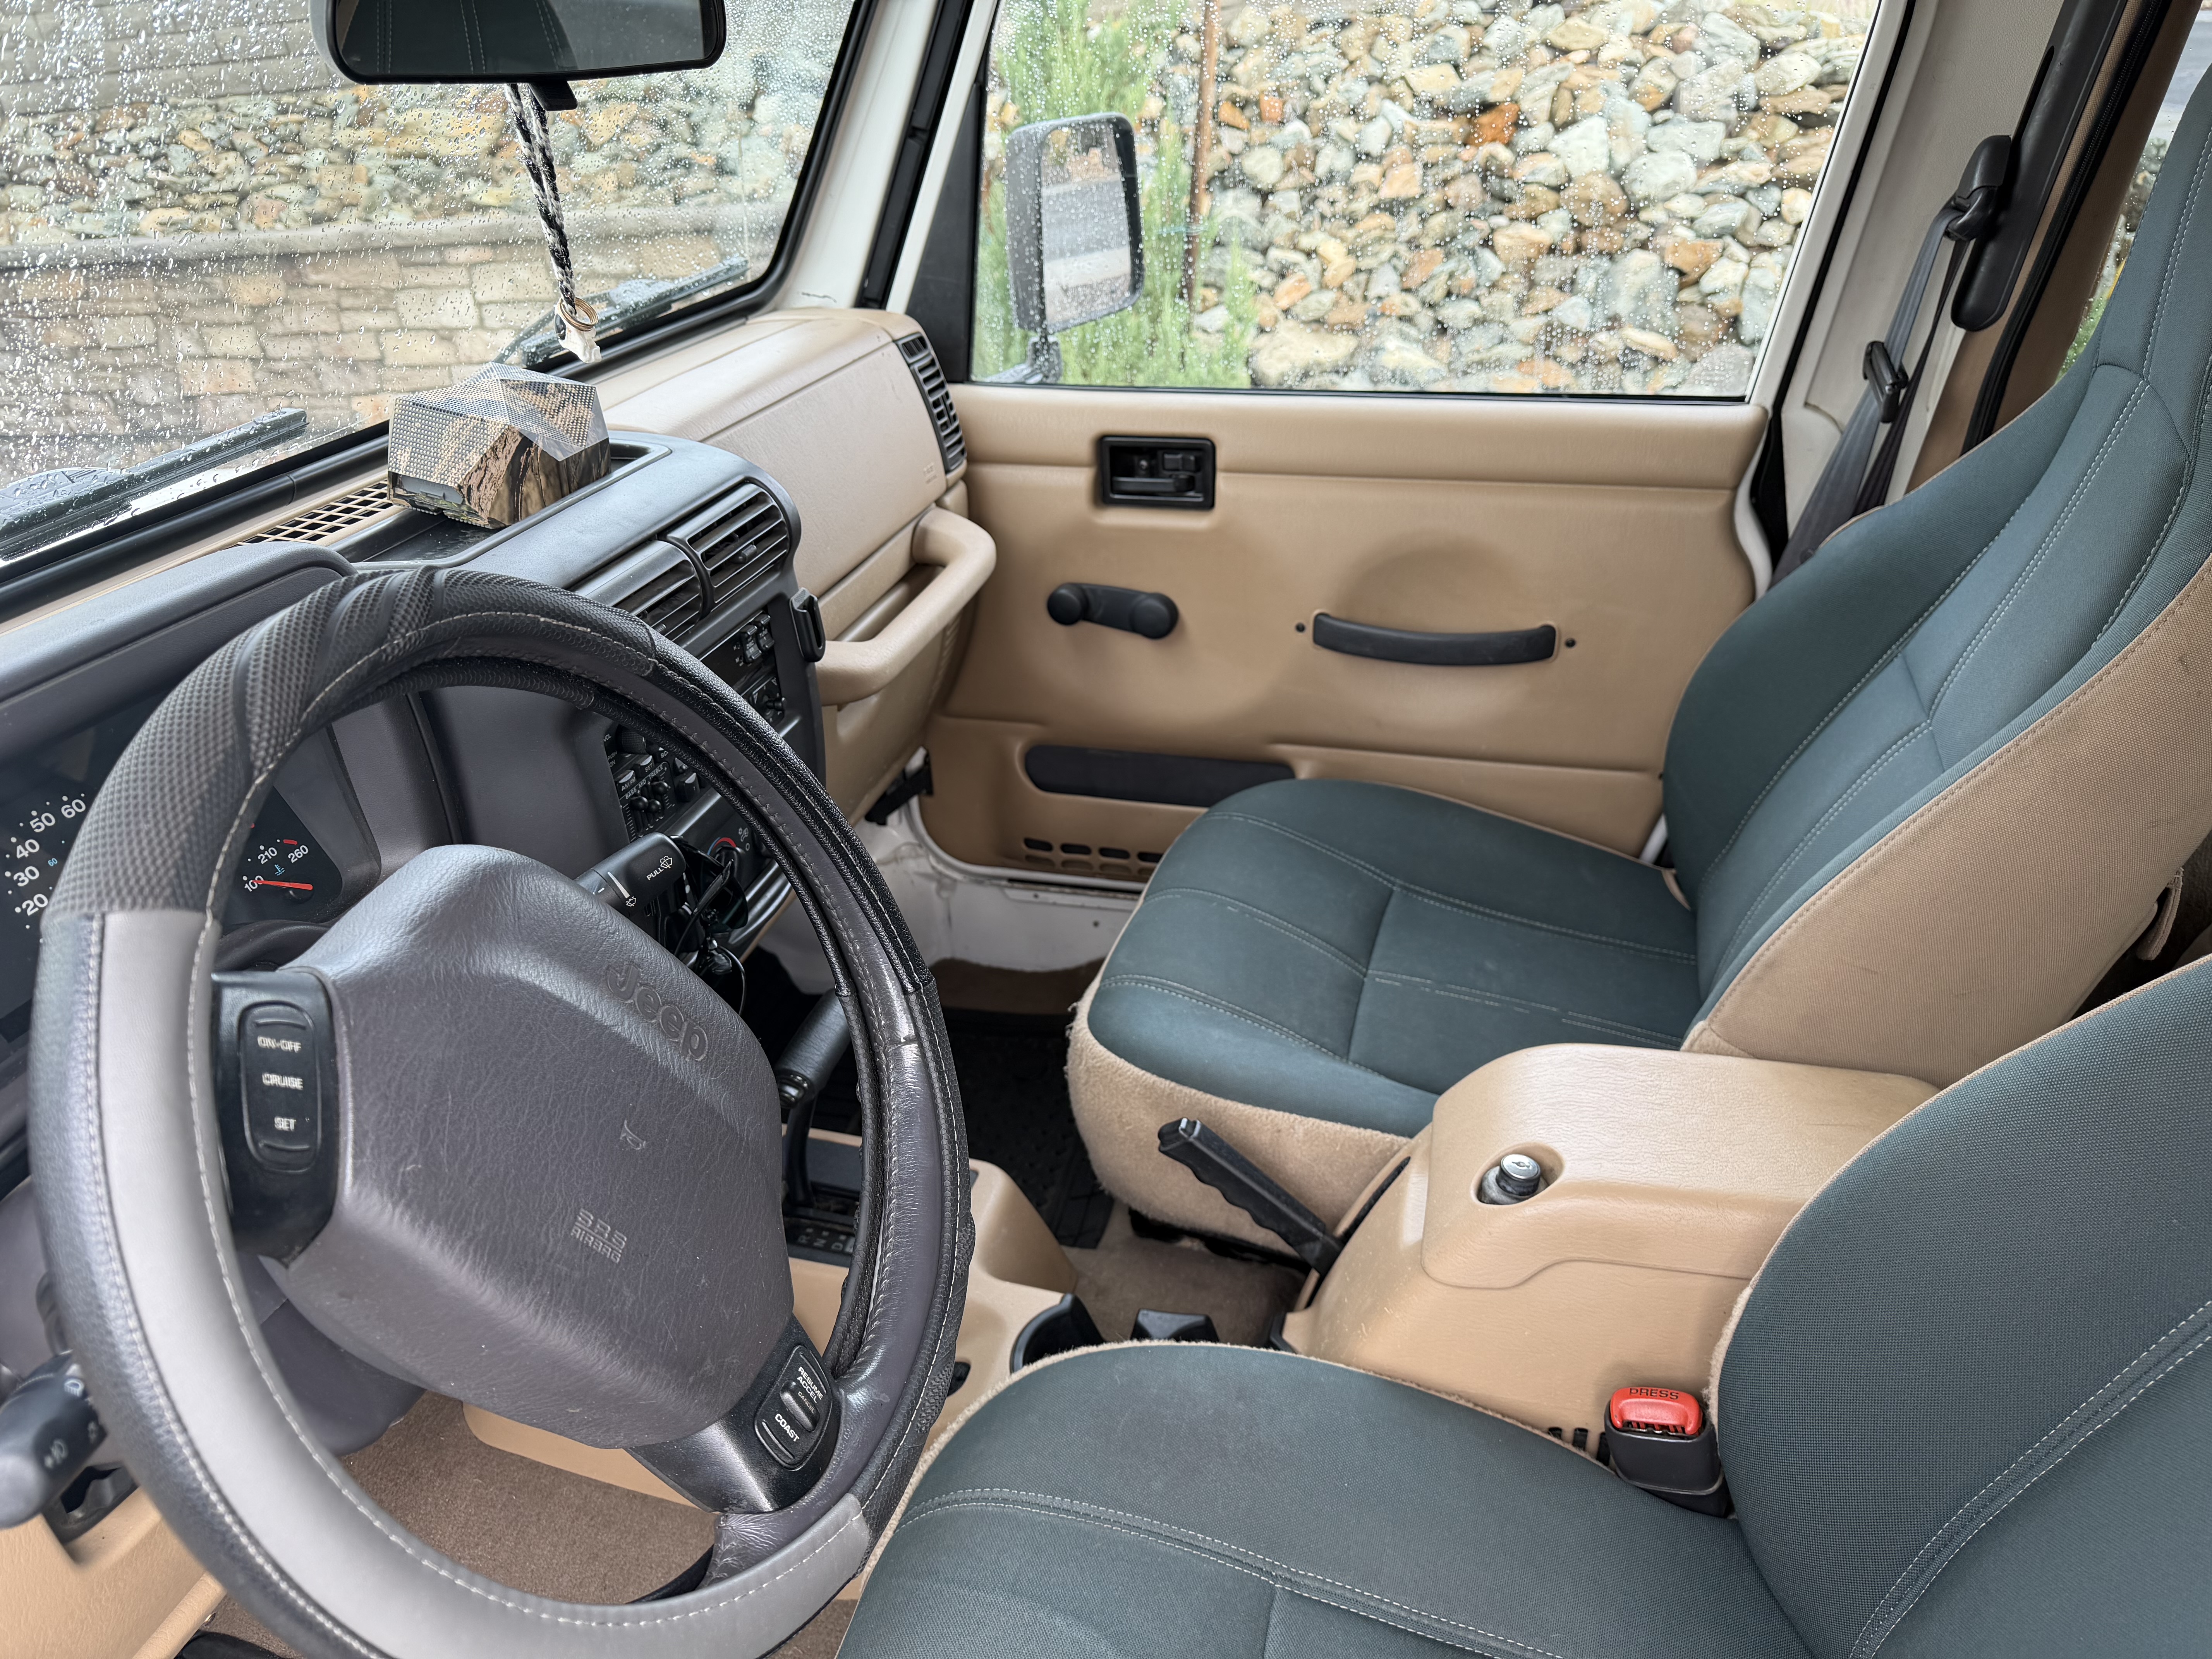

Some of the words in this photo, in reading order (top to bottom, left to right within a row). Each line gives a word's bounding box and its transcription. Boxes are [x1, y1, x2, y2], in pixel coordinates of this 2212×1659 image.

[603, 734, 612, 742] VOL
[625, 787, 637, 799] BASS
[648, 764, 663, 780] TREBLE
[61, 799, 86, 818] 60
[29, 813, 55, 832] 50
[16, 839, 40, 859] 40
[258, 847, 277, 864] 210
[288, 845, 309, 863] 260
[48, 858, 58, 866] 60
[13, 866, 40, 886] 30
[244, 875, 264, 892] 100
[646, 867, 664, 881] PULL
[22, 894, 48, 916] 20
[605, 962, 709, 1062] Jeep
[257, 1036, 302, 1053] ON-OFF
[262, 1072, 303, 1091] CRUISE
[274, 1116, 296, 1132] SET
[576, 1207, 627, 1249] SRS
[570, 1225, 621, 1264] AIRBAG
[797, 1376, 817, 1404] ACCEL
[798, 1366, 823, 1400] RESUME
[798, 1391, 815, 1414] CANCEL
[1629, 1388, 1679, 1400] PRESS
[775, 1413, 800, 1442] COAST
